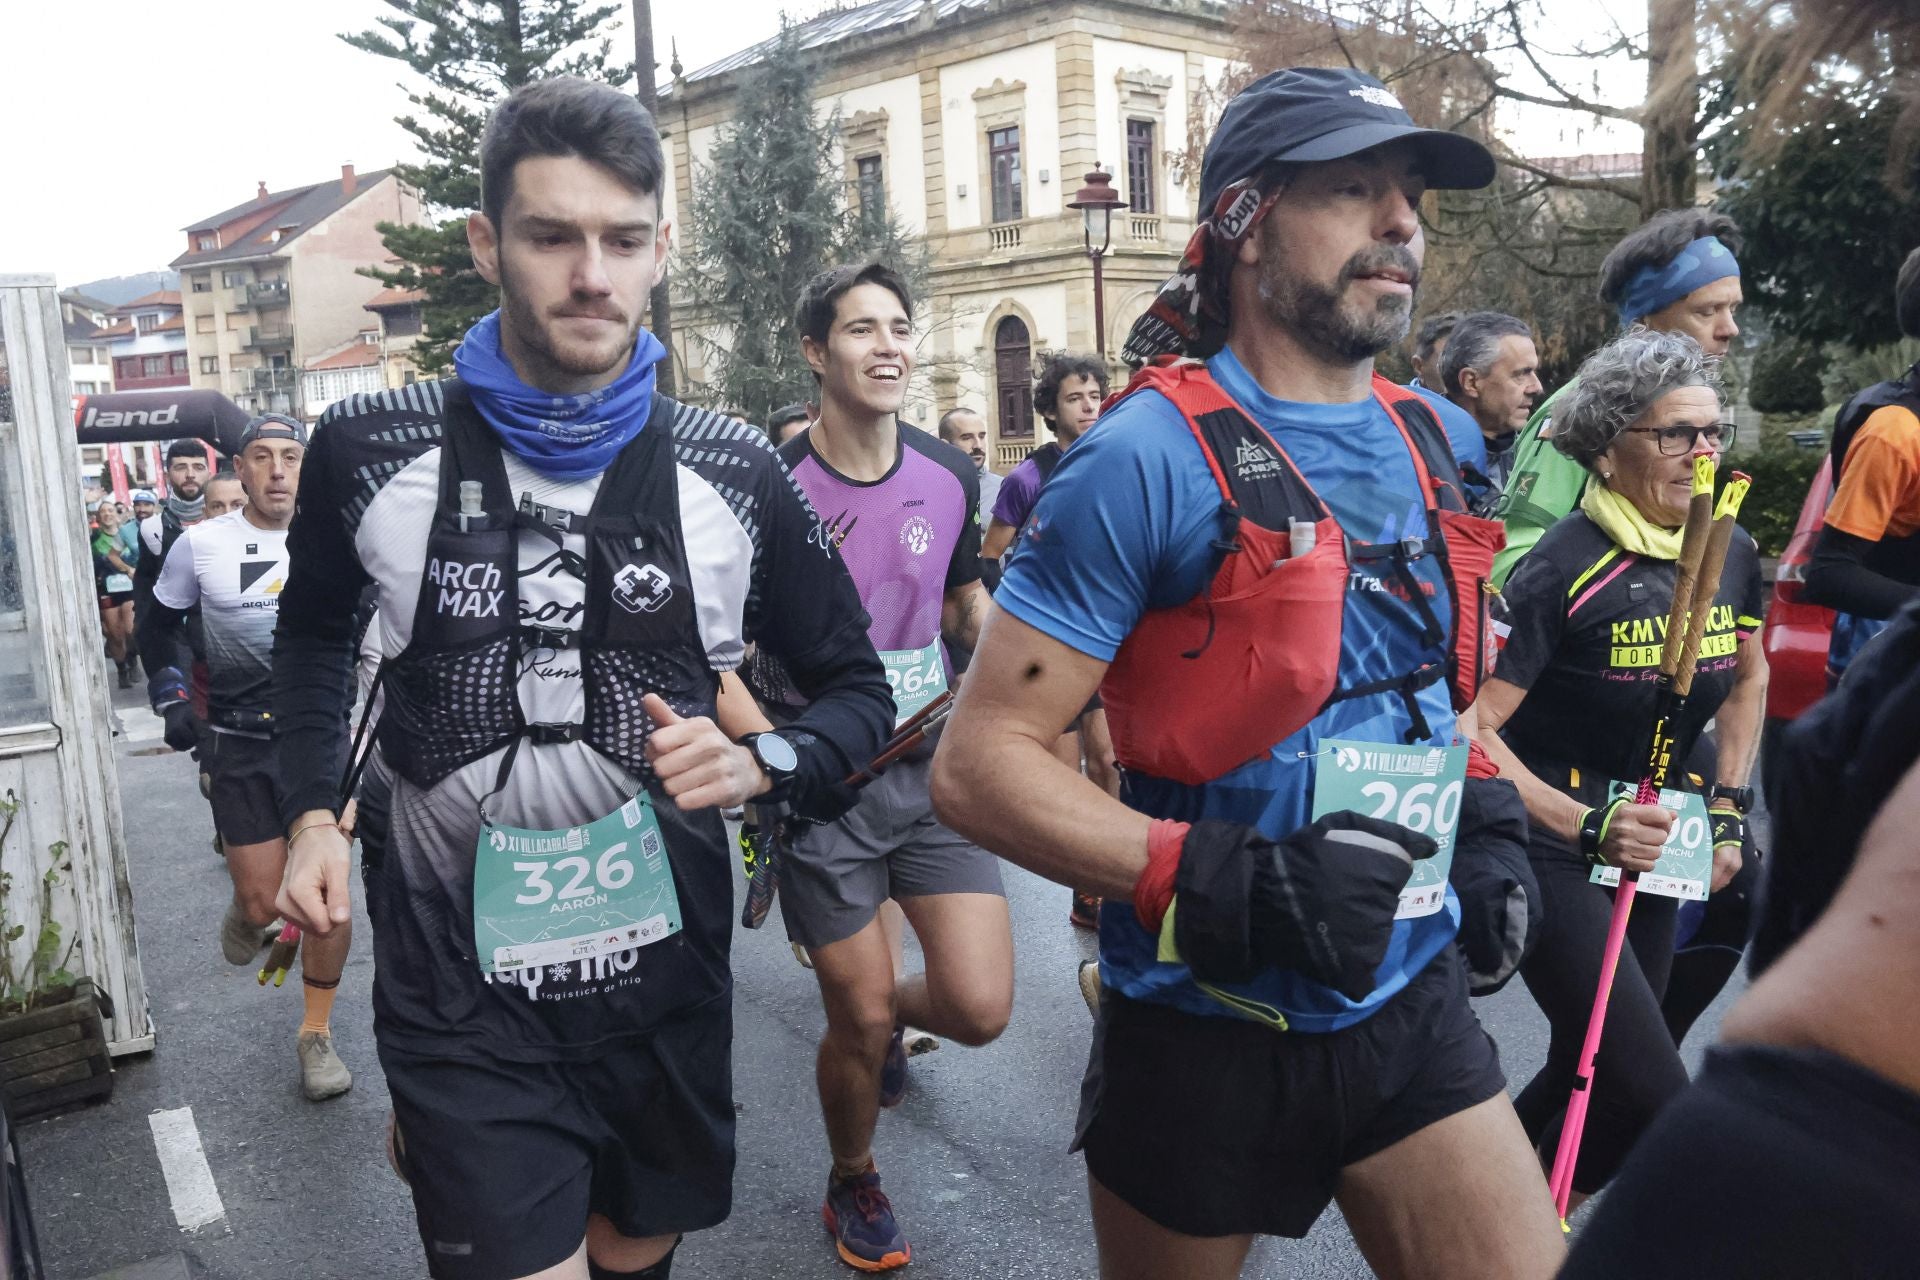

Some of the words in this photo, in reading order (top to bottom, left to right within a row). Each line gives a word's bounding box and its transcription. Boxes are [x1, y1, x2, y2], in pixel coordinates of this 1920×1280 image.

[1220, 193, 1259, 236] Buff
[437, 587, 505, 618] MAX
[1611, 618, 1655, 644] KM
[886, 660, 941, 695] 264
[1653, 738, 1674, 787] LEKI
[1361, 780, 1463, 834] 260
[520, 836, 568, 854] VILLACABRA
[1661, 846, 1695, 858] ENCHU
[513, 841, 635, 905] 326
[549, 893, 608, 914] AARÓN
